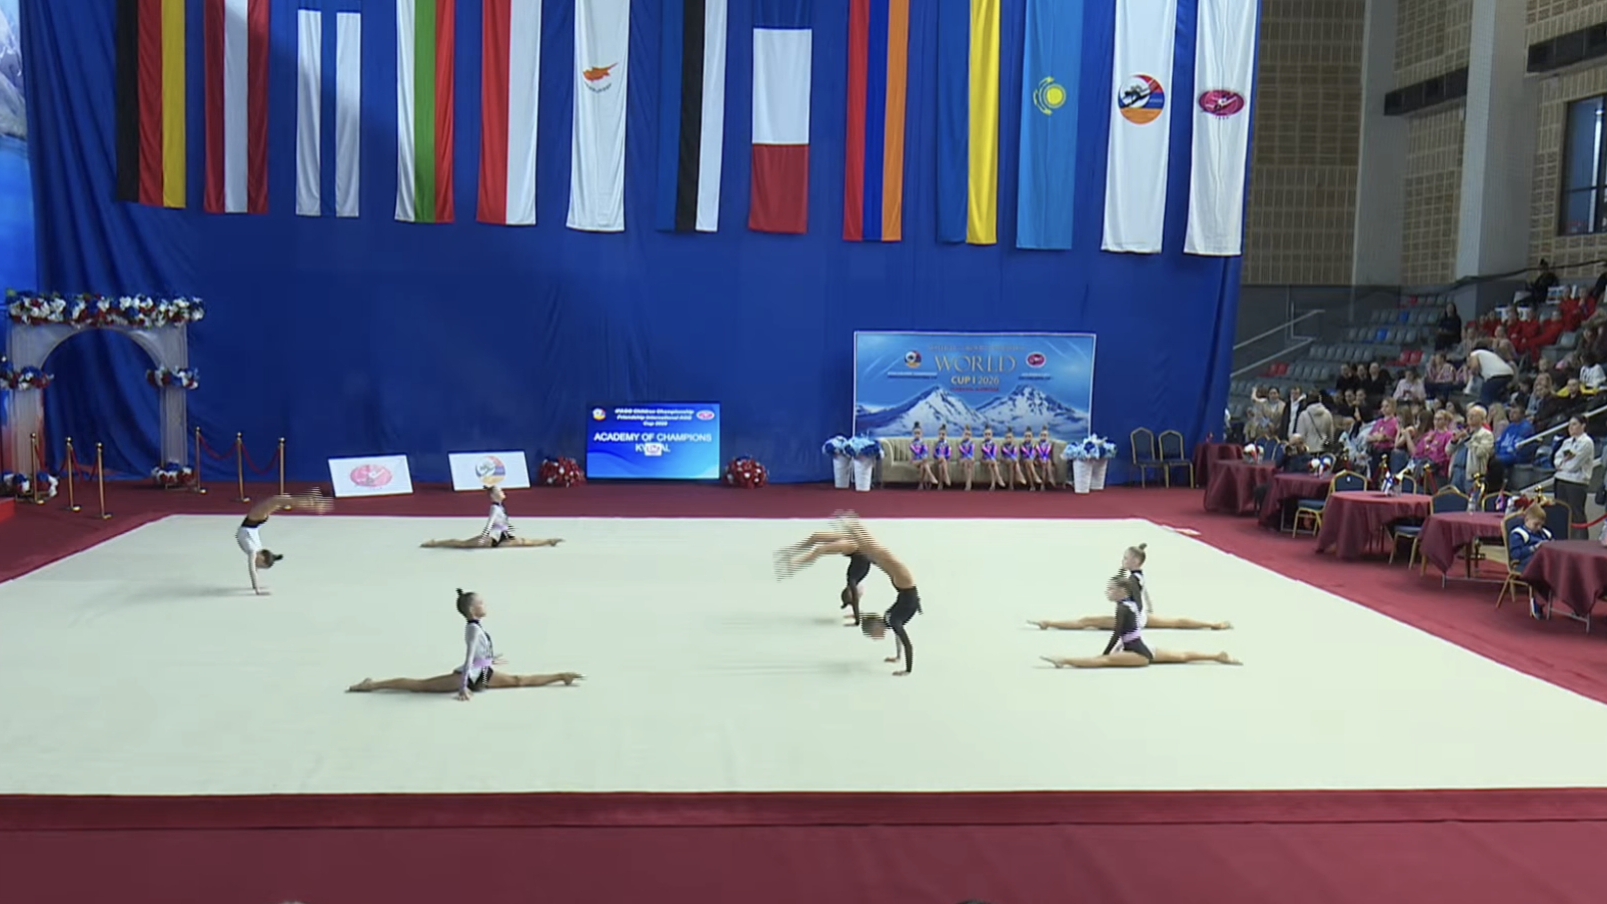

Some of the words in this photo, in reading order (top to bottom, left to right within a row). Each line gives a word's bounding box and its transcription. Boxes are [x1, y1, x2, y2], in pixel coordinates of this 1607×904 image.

[934, 354, 1016, 373] WORLD
[950, 375, 971, 385] CUP
[977, 376, 1000, 386] 2026
[594, 432, 640, 442] ACADEMY
[641, 432, 655, 442] OF
[656, 432, 712, 443] CHAMPIONS
